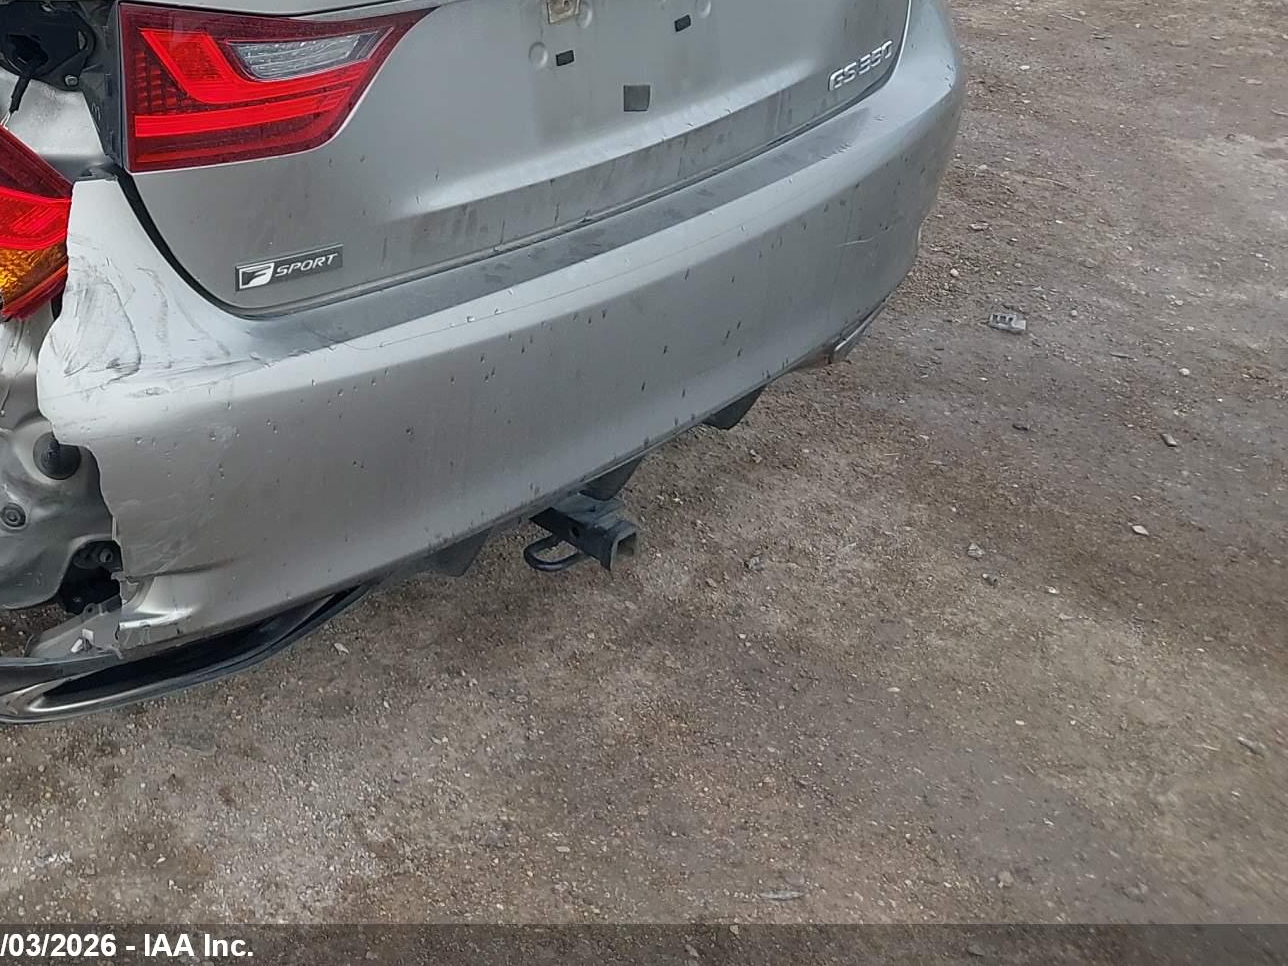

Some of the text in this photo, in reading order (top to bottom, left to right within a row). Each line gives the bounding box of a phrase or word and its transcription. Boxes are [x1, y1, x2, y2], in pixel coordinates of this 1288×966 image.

[829, 40, 893, 91] GS 350
[274, 253, 339, 277] SPORT
